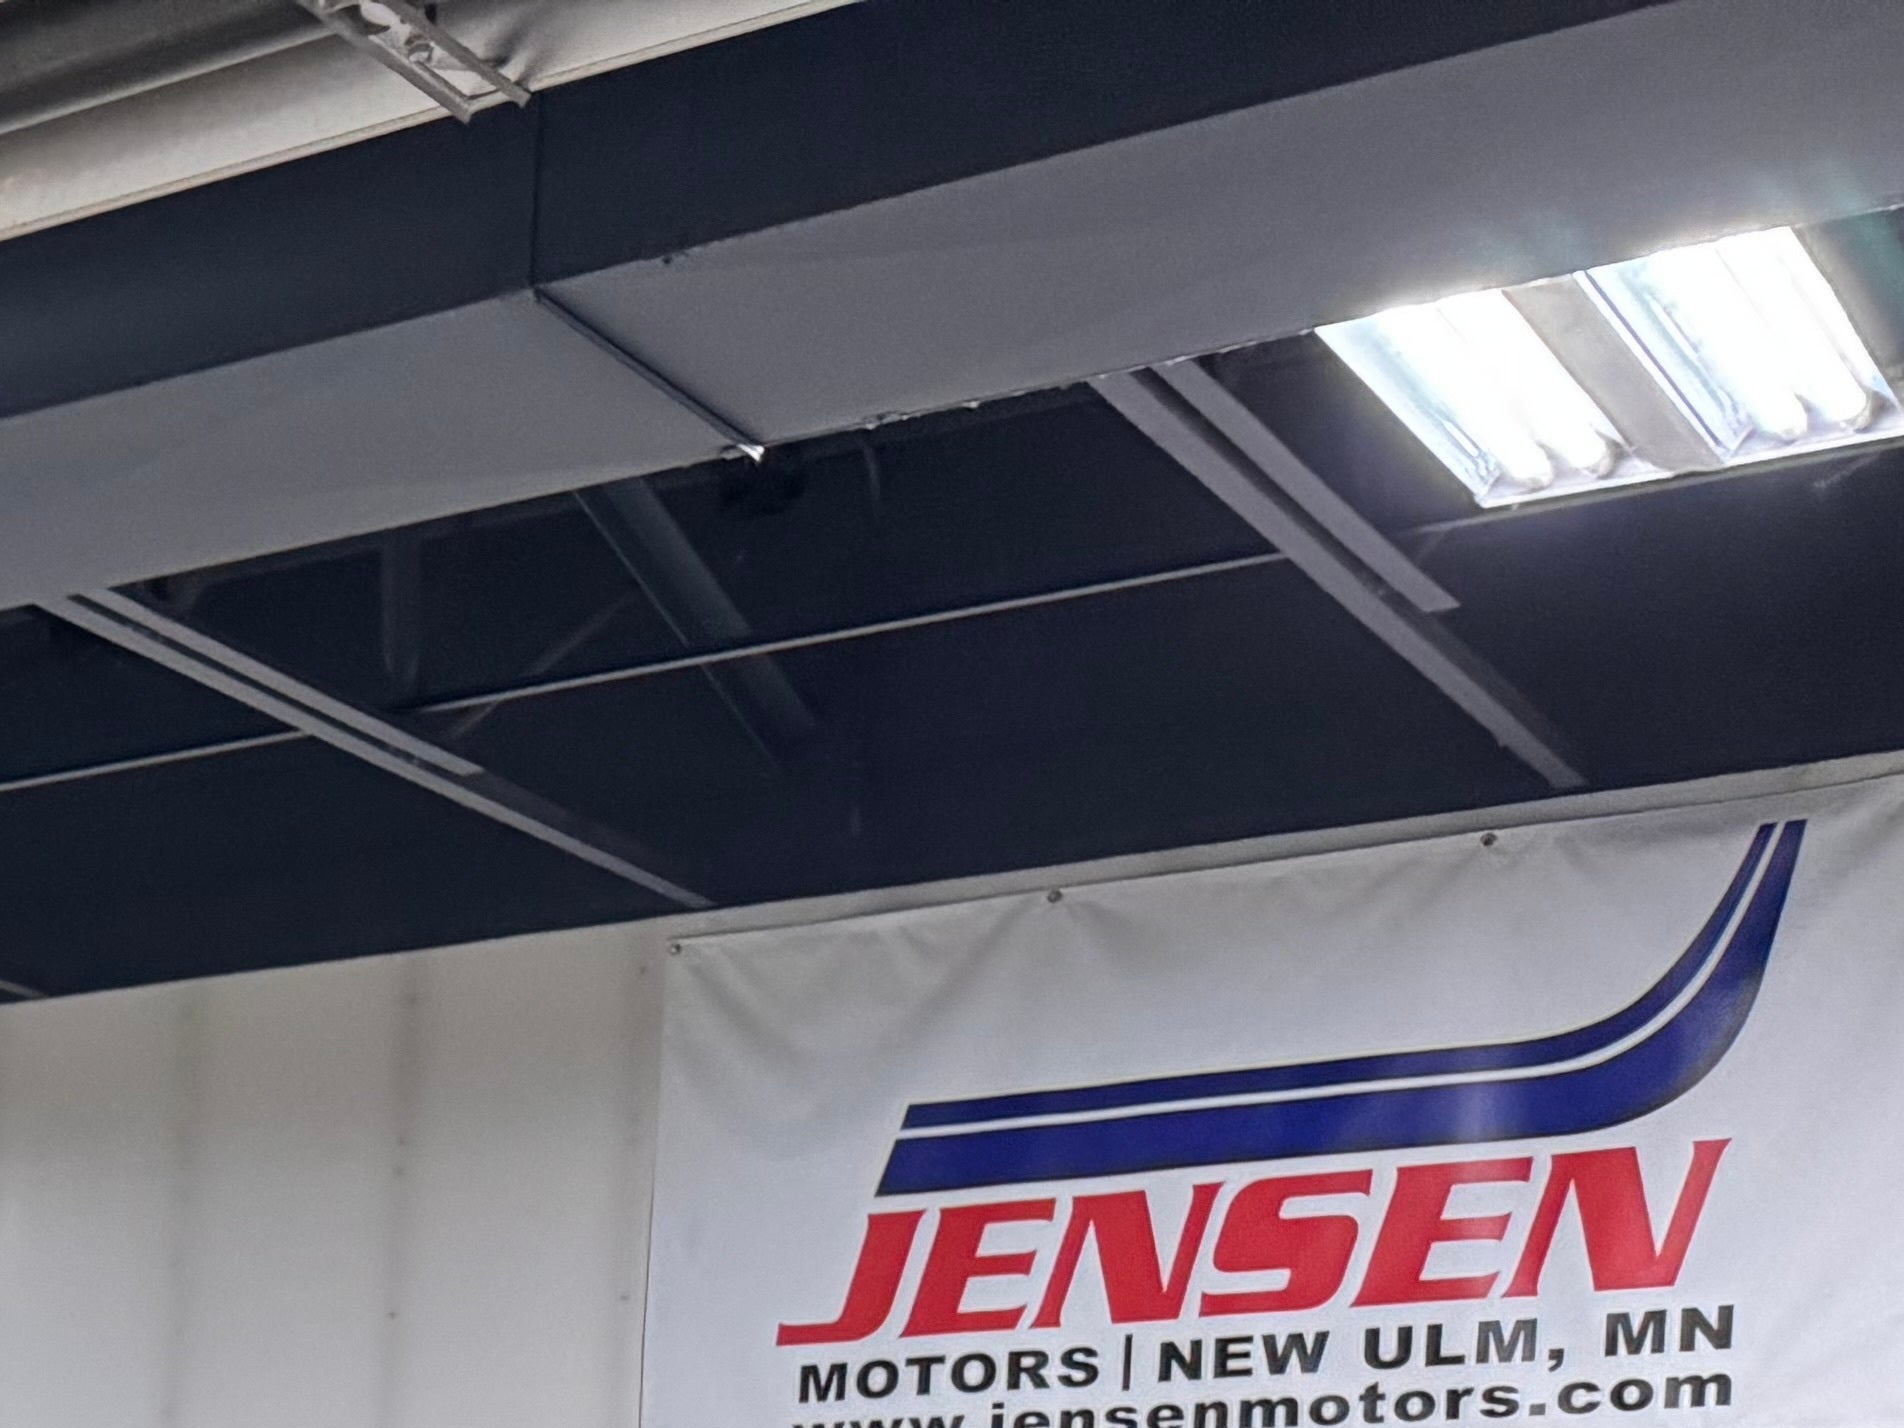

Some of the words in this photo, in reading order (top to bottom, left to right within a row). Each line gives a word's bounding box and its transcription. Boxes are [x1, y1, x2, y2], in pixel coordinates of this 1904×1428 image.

[776, 1138, 1733, 1346] JENSEN
[798, 1346, 1099, 1403] MOTORS
[1157, 1330, 1330, 1383] NEW
[1363, 1317, 1566, 1371] ULM,
[1604, 1304, 1735, 1357] MN
